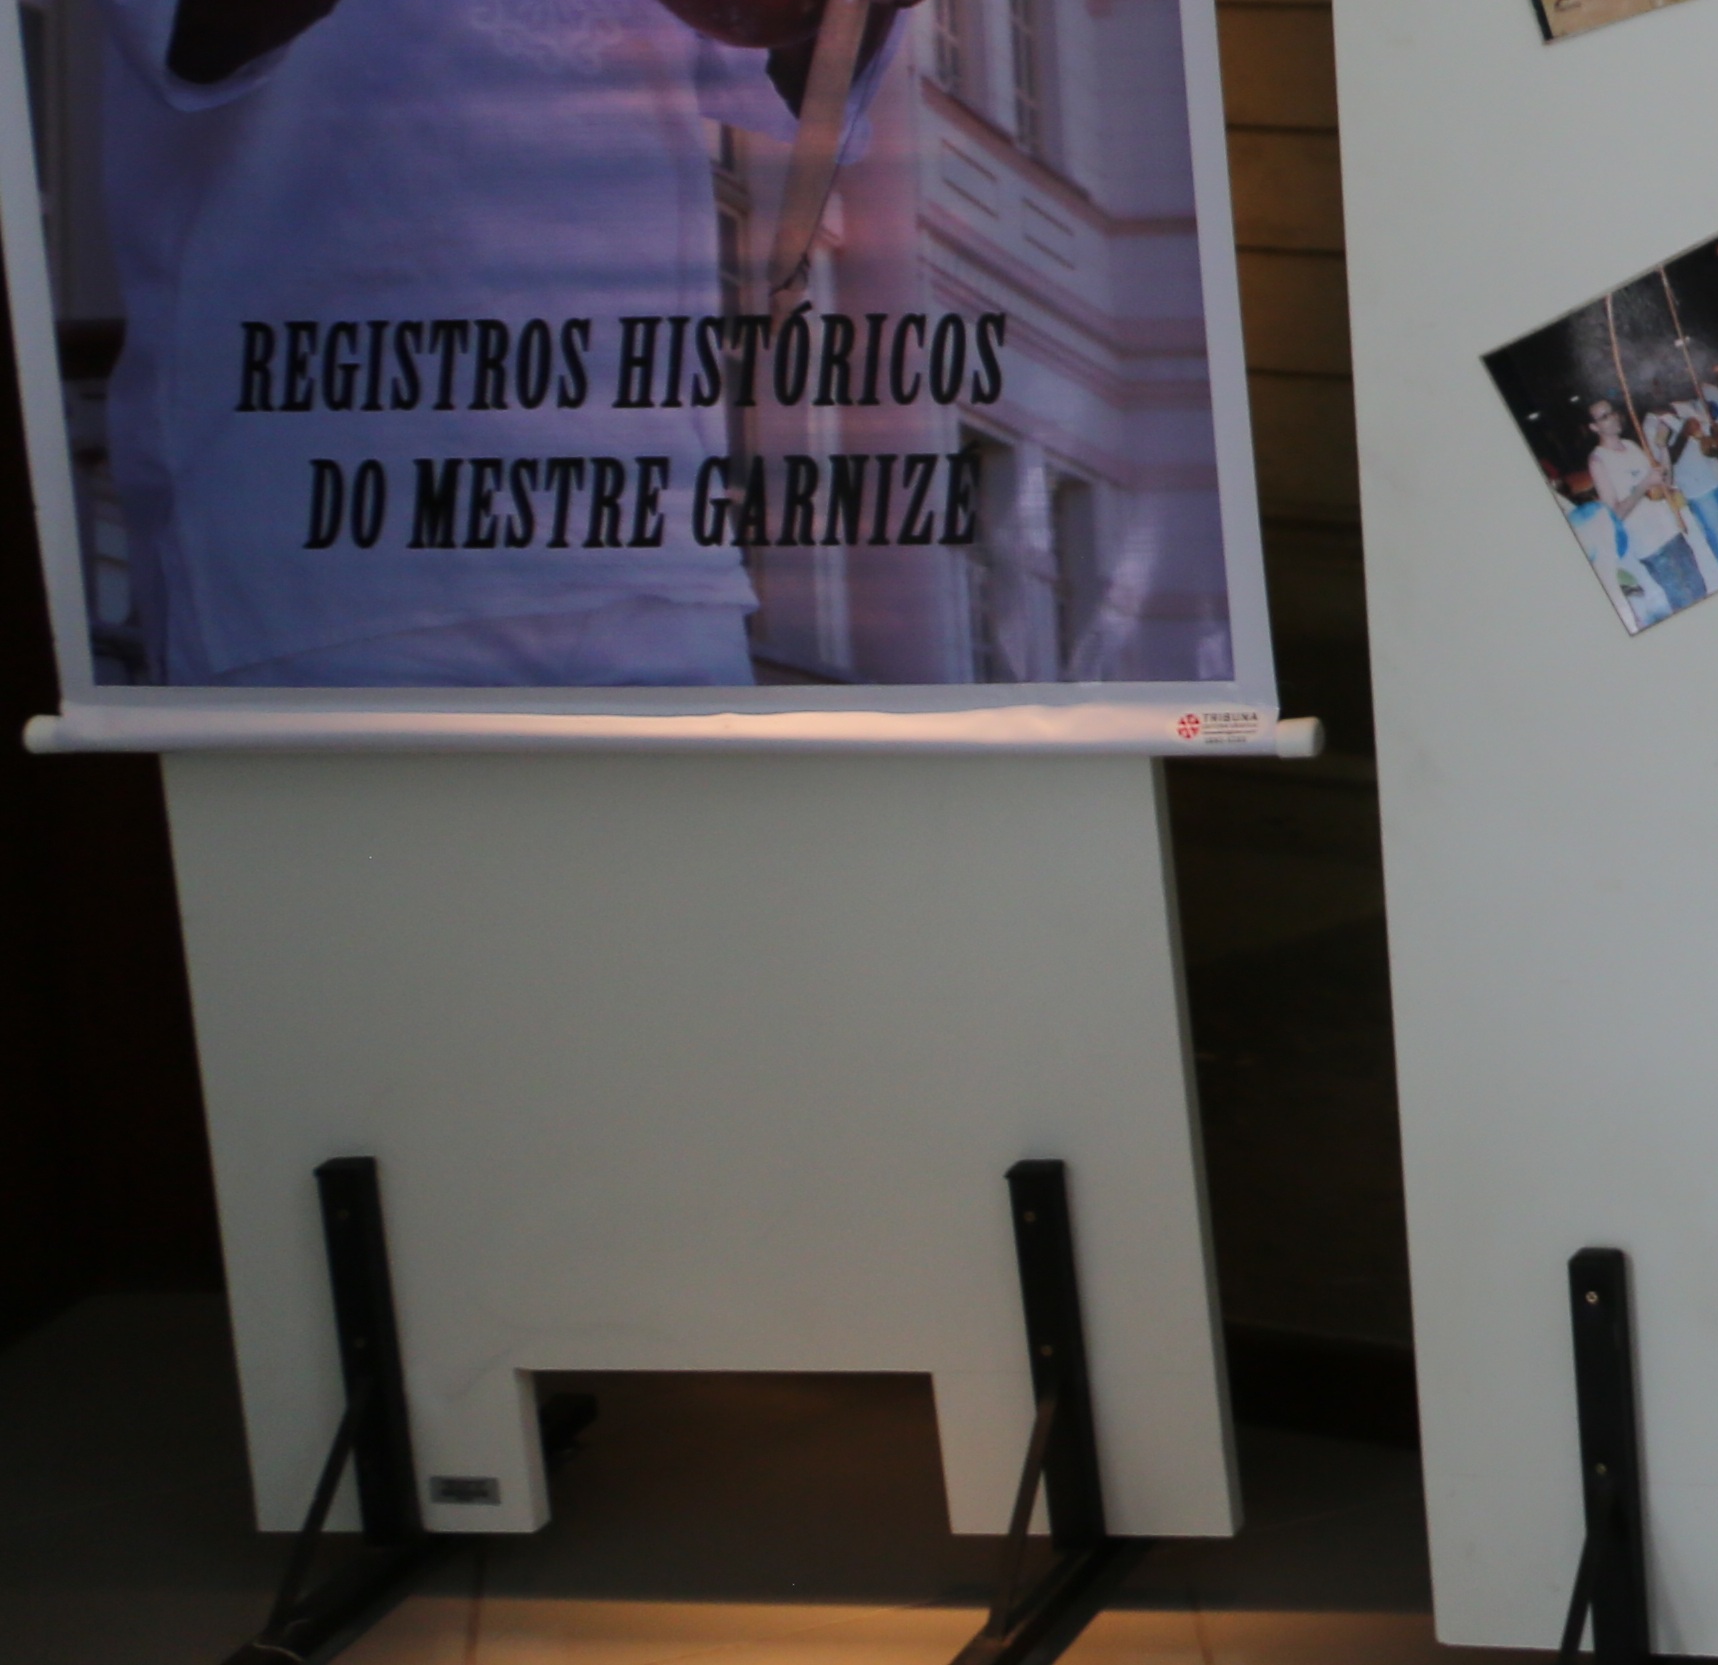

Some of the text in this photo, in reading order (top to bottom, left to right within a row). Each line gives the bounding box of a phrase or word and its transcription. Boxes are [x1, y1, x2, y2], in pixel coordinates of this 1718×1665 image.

[234, 299, 1008, 413] REGISTROS HISTÓRICOS
[303, 442, 983, 550] DO MESTRE GARNIZÉ
[1203, 711, 1258, 723] TRIBUNA
